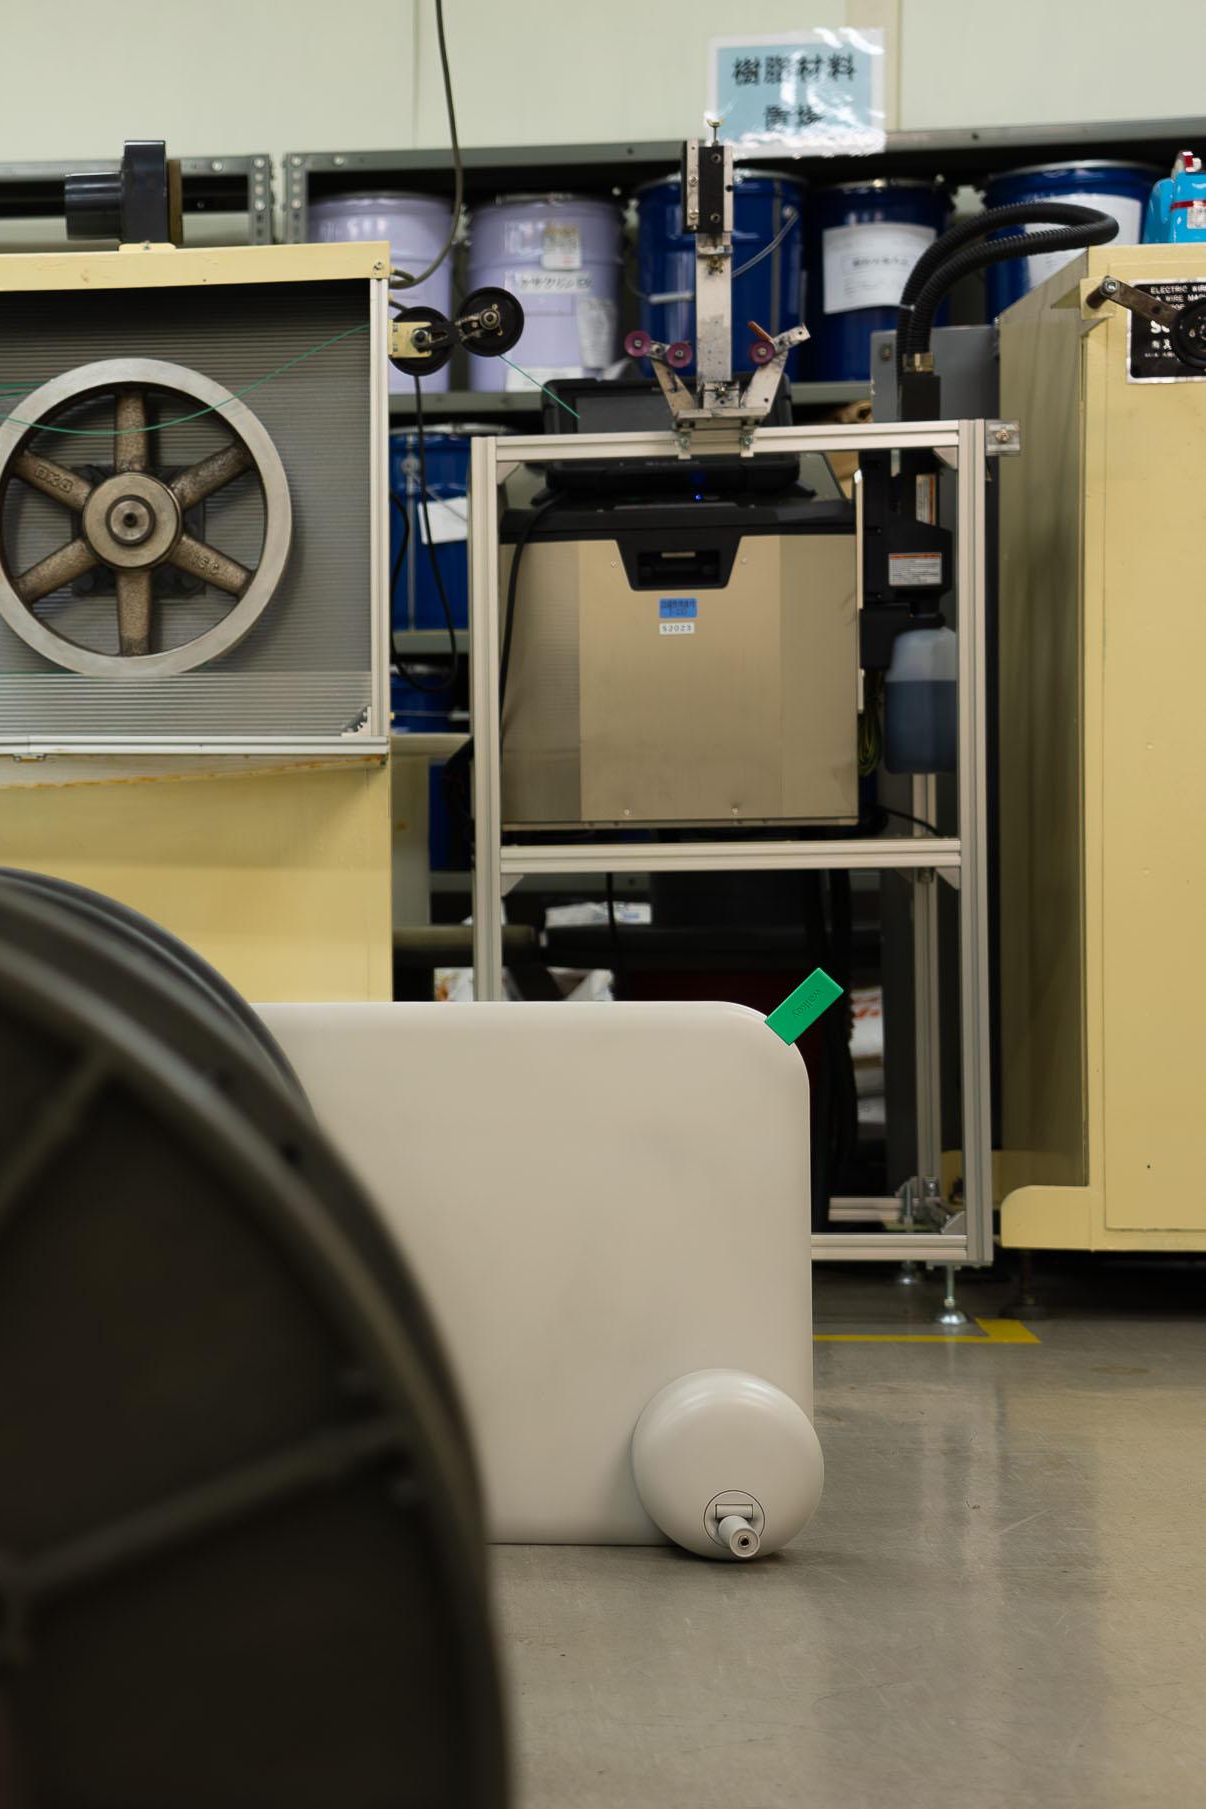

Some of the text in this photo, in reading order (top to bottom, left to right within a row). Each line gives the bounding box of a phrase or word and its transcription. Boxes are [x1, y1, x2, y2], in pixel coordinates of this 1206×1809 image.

[732, 53, 856, 85] 樹脂材料
[1150, 285, 1188, 295] ELECTRIC
